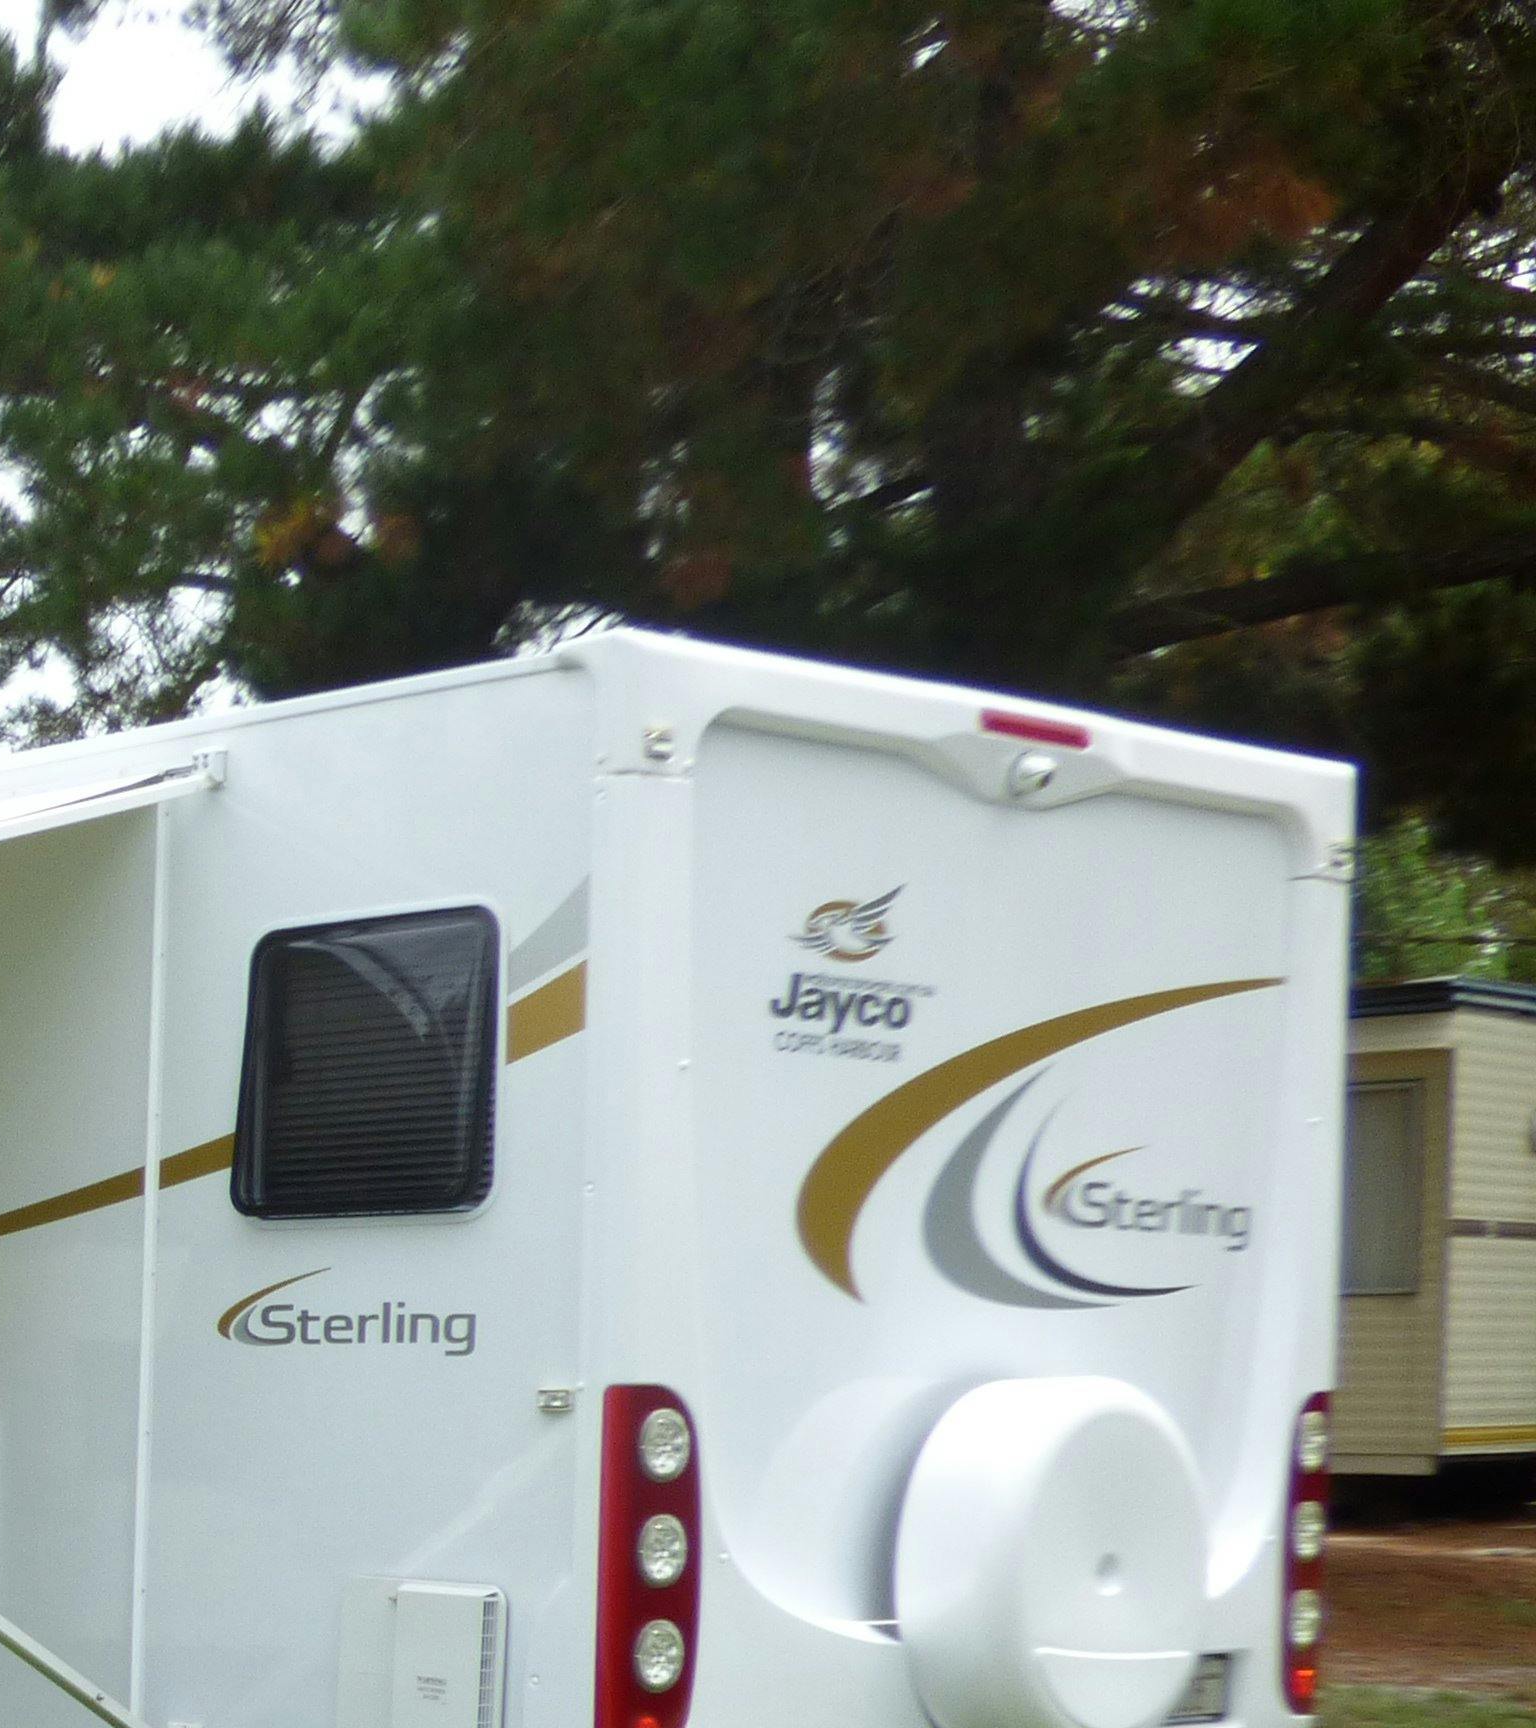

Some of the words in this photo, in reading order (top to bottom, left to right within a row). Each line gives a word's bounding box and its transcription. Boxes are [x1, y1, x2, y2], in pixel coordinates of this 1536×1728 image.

[770, 972, 911, 1033] Jayco
[1066, 1181, 1251, 1251] Sterling
[247, 1301, 477, 1356] Sterling
